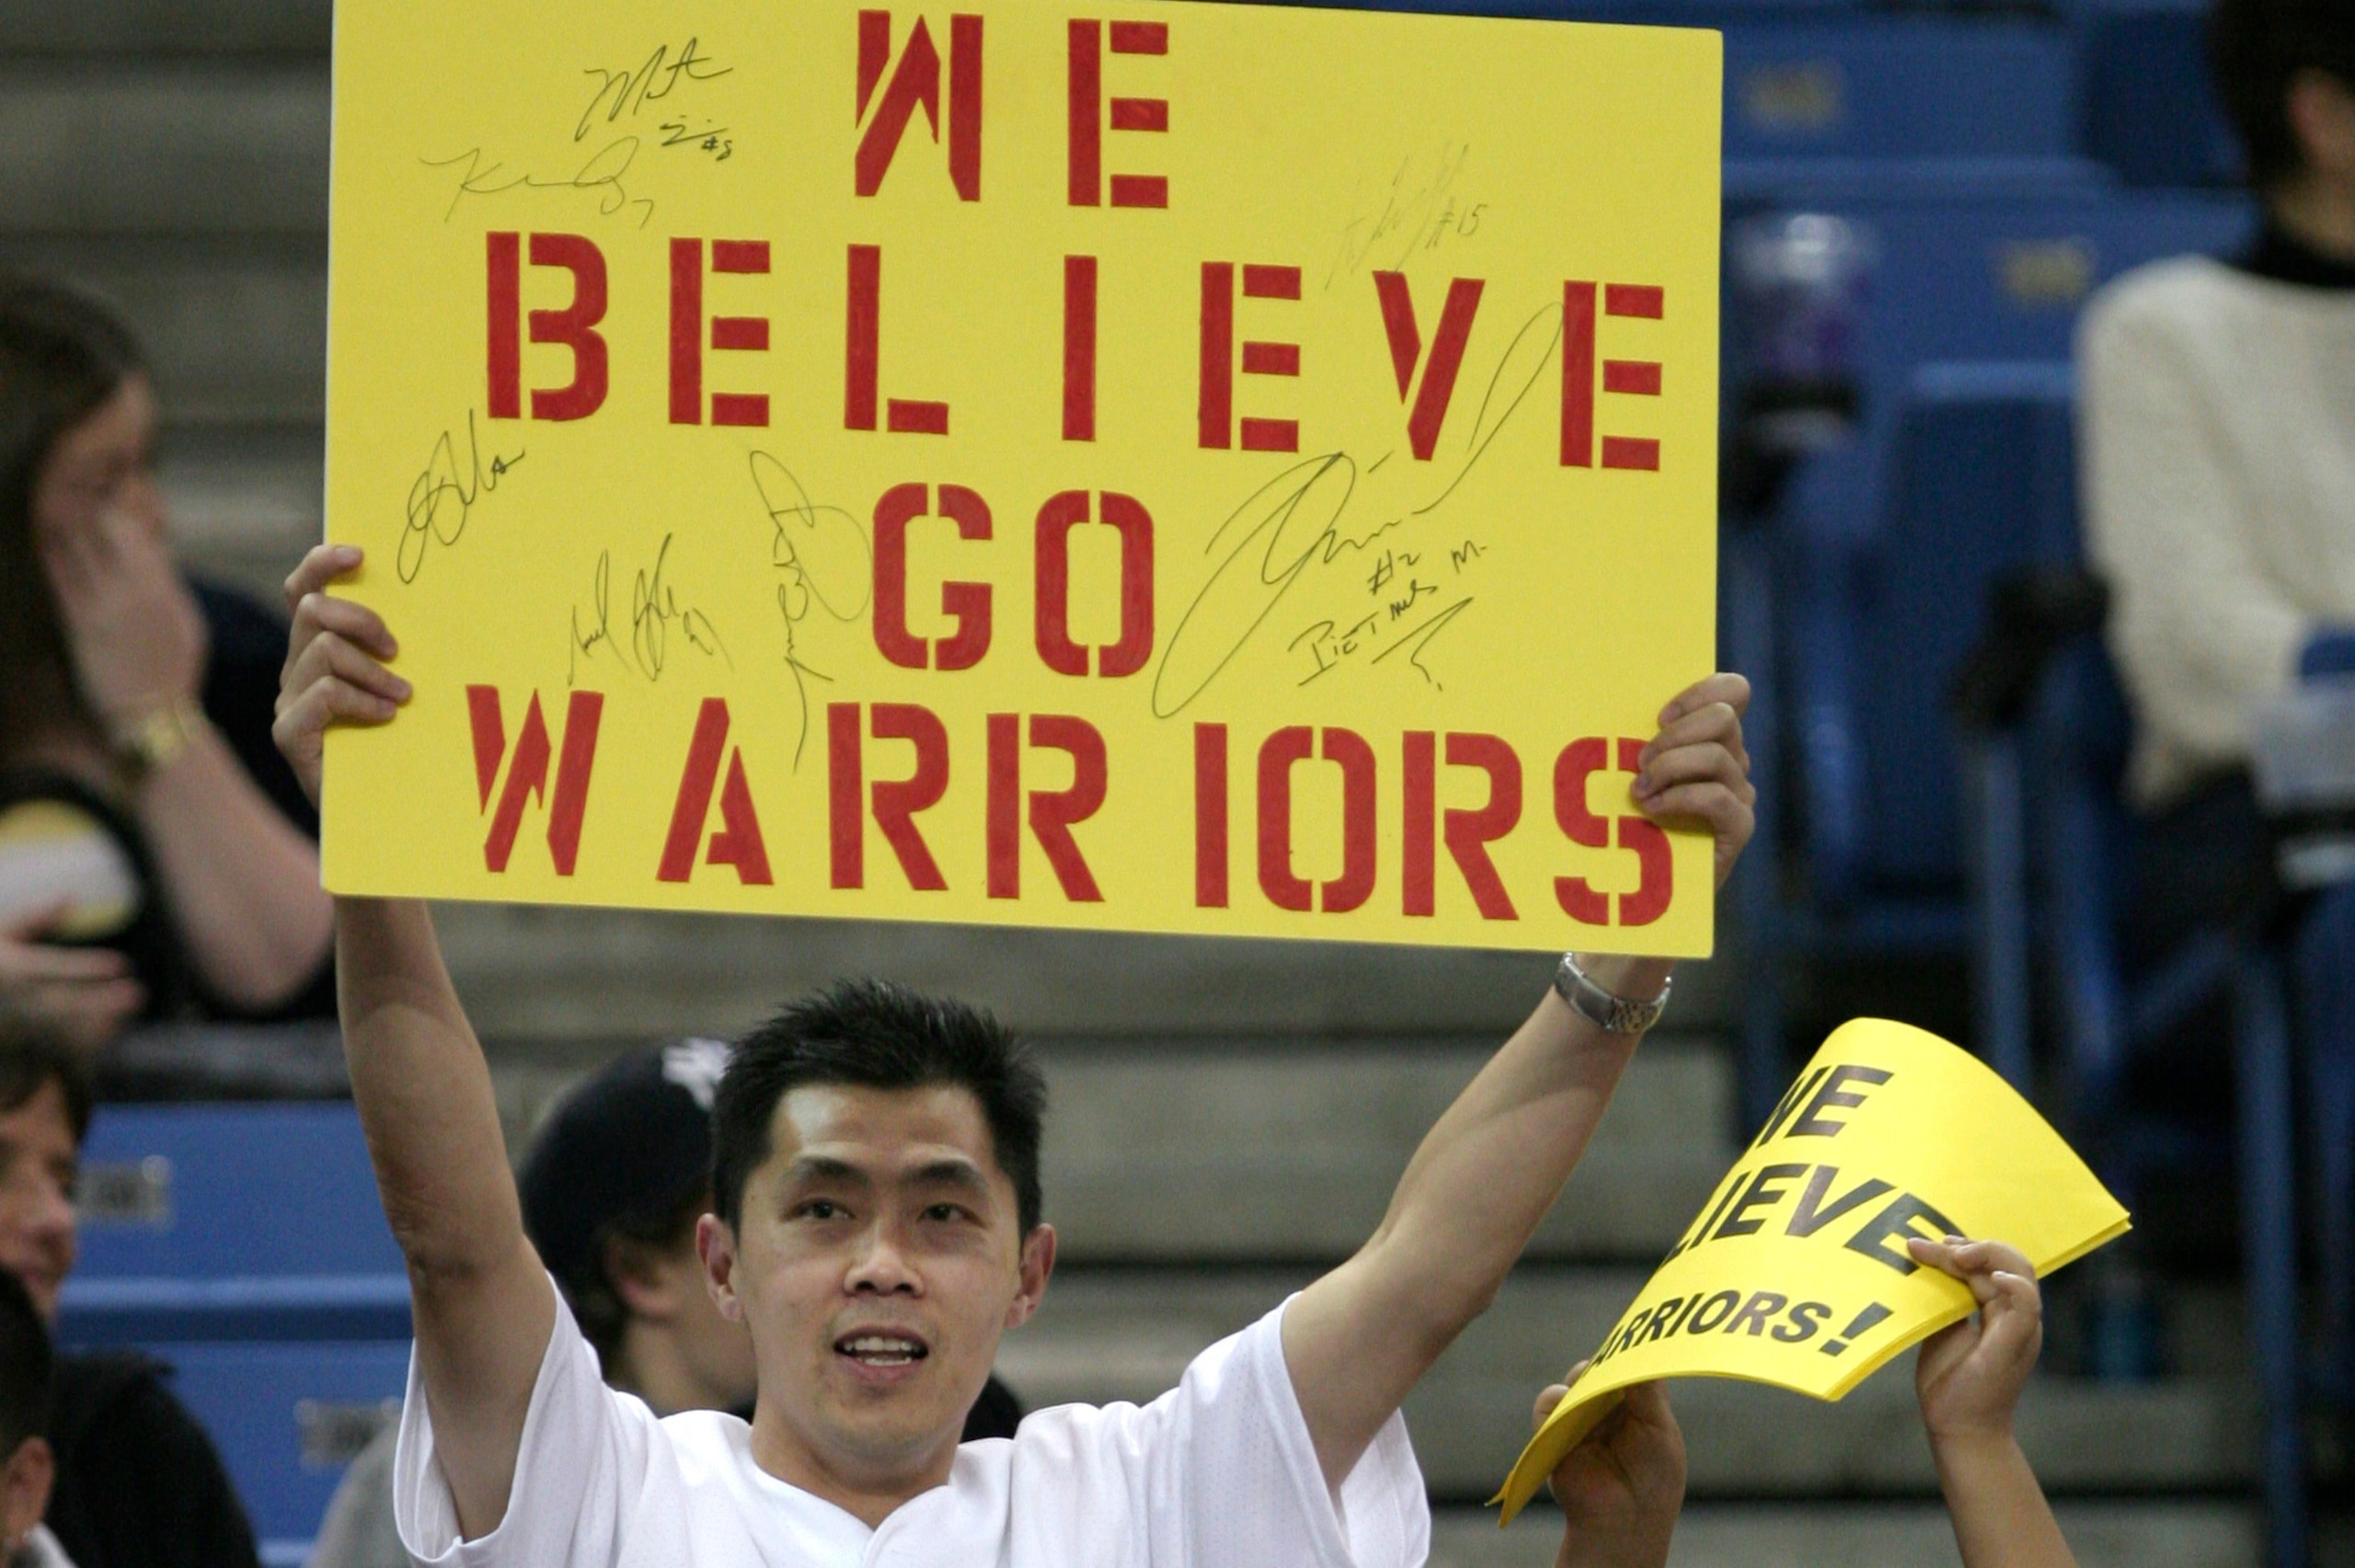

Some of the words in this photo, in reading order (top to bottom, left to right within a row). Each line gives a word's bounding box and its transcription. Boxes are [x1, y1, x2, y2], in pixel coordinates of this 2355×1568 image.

[856, 10, 1168, 208] WE
[487, 232, 1663, 471] BELIEVE
[873, 484, 1154, 677] GO
[467, 686, 1673, 925] WARRIORS
